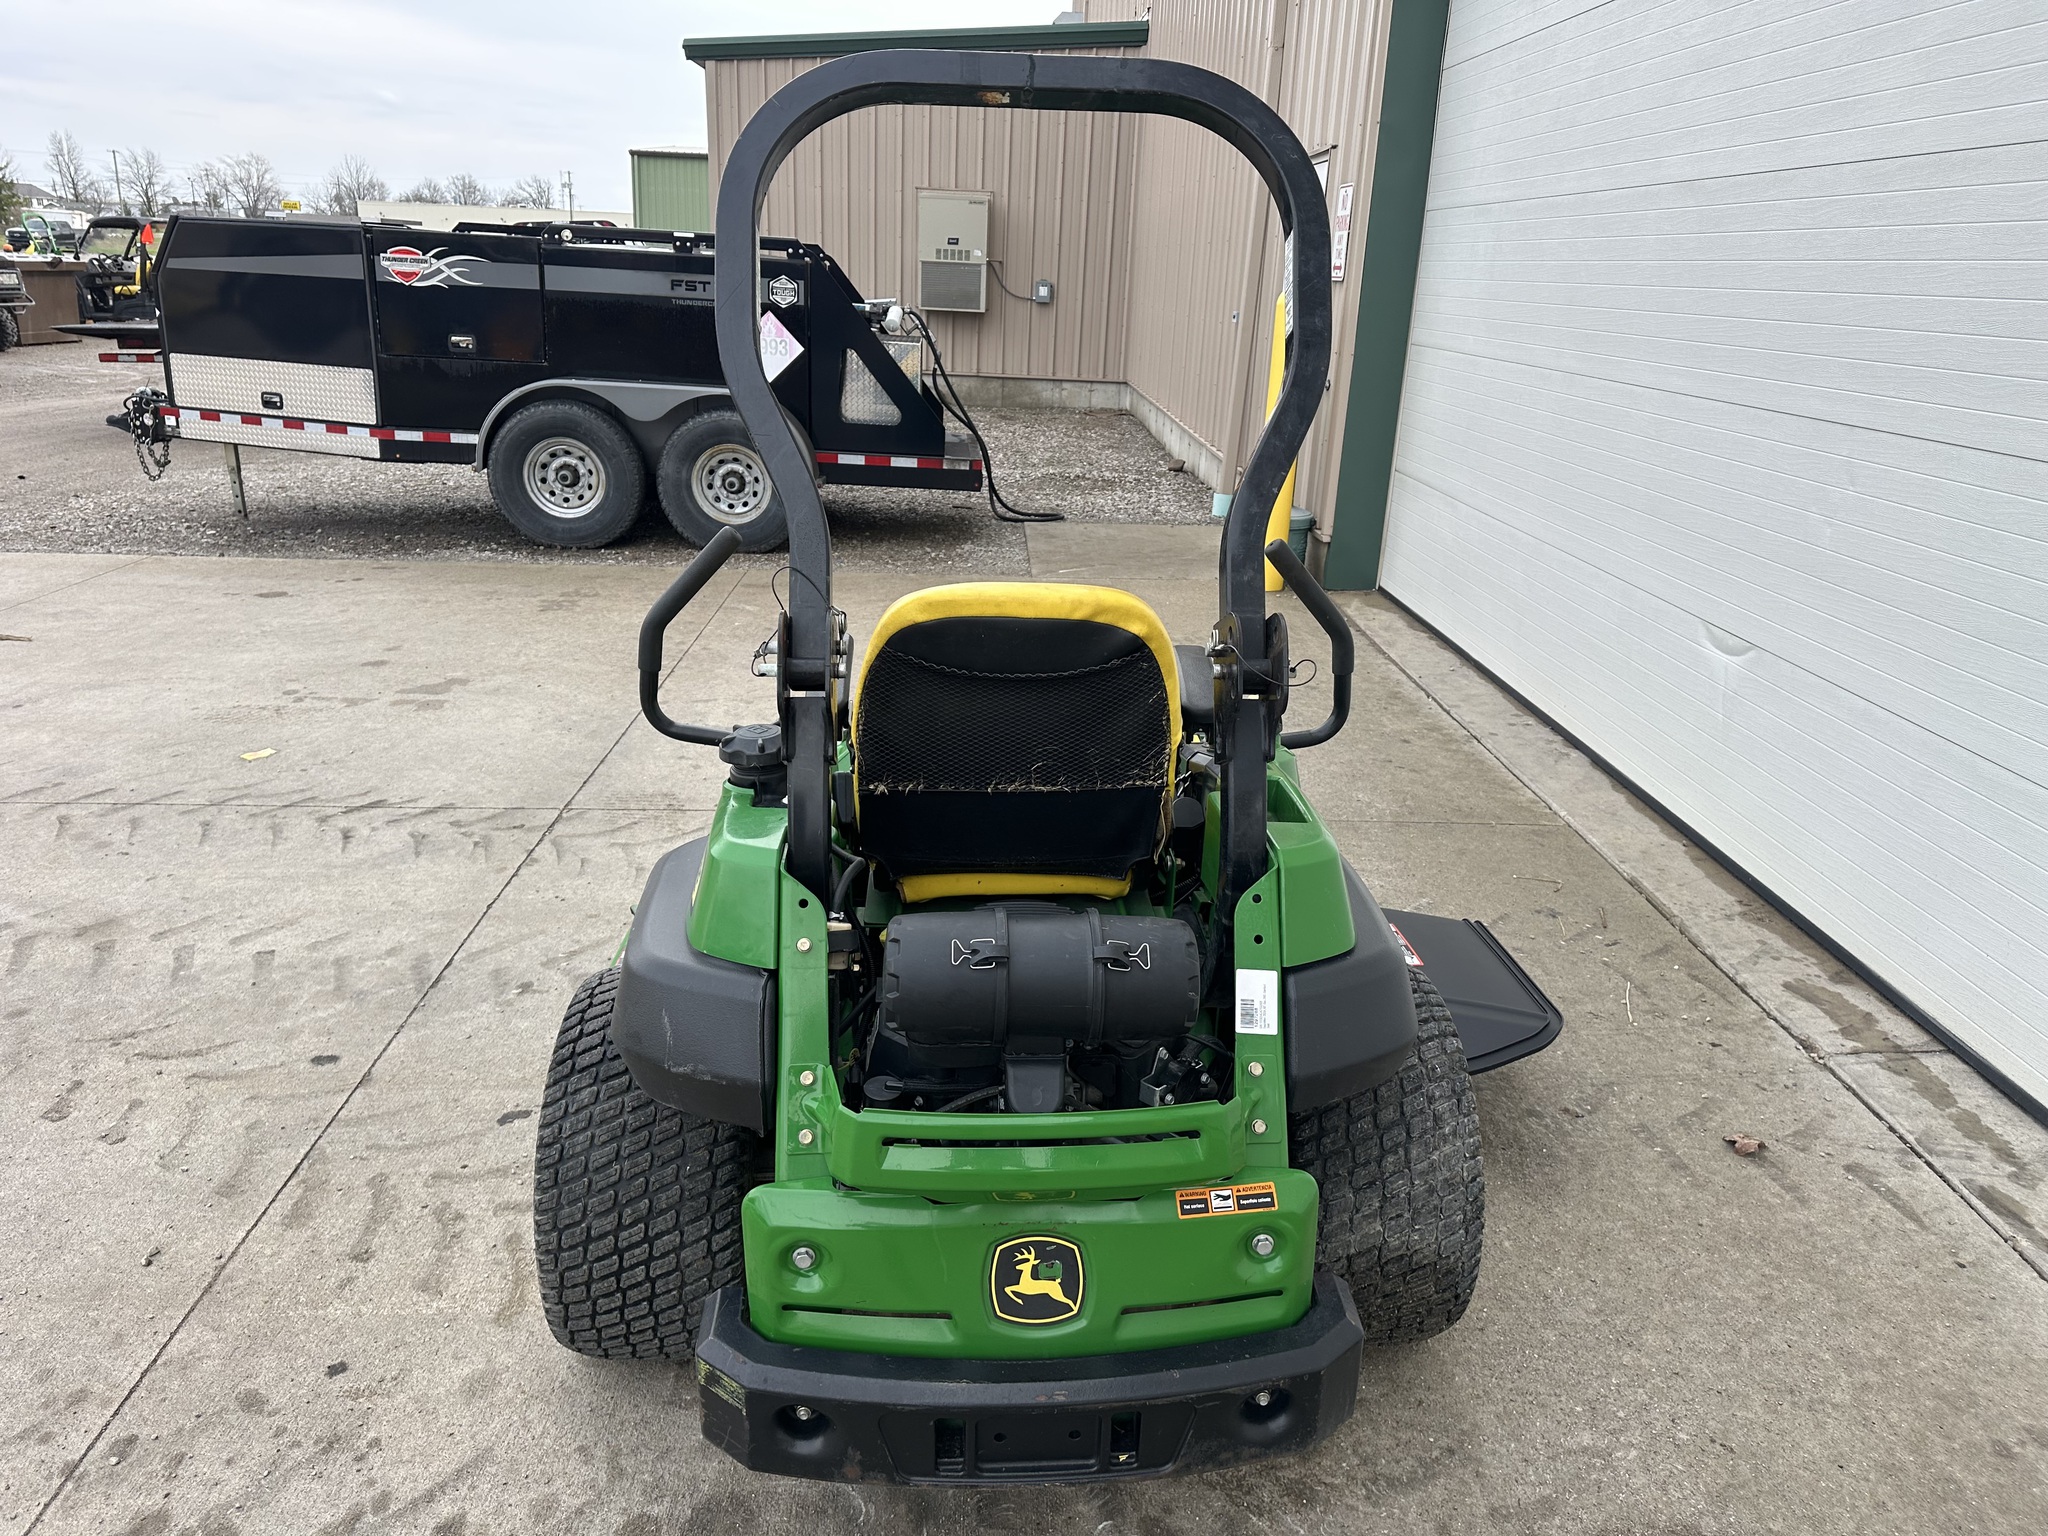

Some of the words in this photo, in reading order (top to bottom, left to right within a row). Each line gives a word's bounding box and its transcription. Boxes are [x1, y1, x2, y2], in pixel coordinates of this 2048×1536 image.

[382, 256, 409, 264] THUNDER
[409, 257, 429, 265] CREEK
[772, 289, 795, 297] TOUGH
[671, 298, 716, 307] THUNDERC
[1242, 1184, 1273, 1193] ADVERTENCIA
[1185, 1190, 1207, 1198] WARNING
